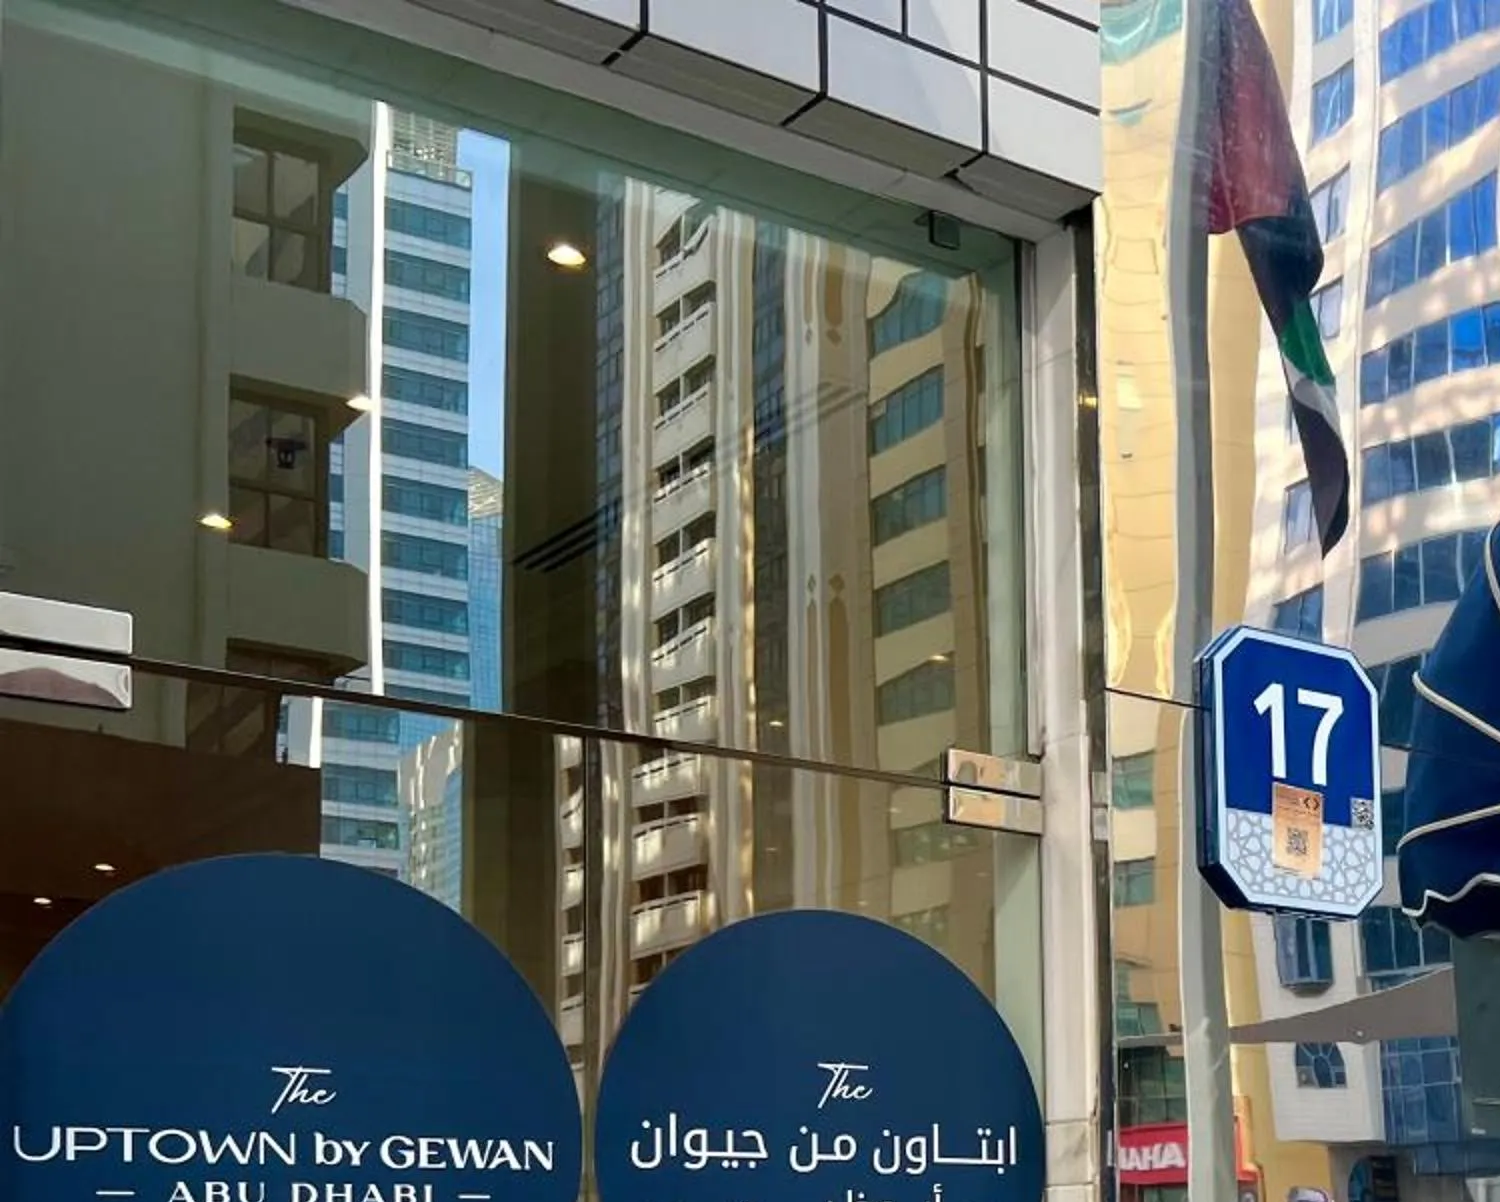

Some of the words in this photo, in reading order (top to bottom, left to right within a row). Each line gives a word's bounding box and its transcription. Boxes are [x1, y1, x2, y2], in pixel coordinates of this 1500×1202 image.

[1253, 682, 1344, 787] 17
[271, 1065, 337, 1115] The
[817, 1062, 873, 1109] The
[13, 1124, 296, 1166] UPTOWN
[314, 1131, 371, 1167] by
[379, 1134, 555, 1172] GEWAN
[630, 1111, 769, 1170] جيوان
[788, 1125, 858, 1173] من
